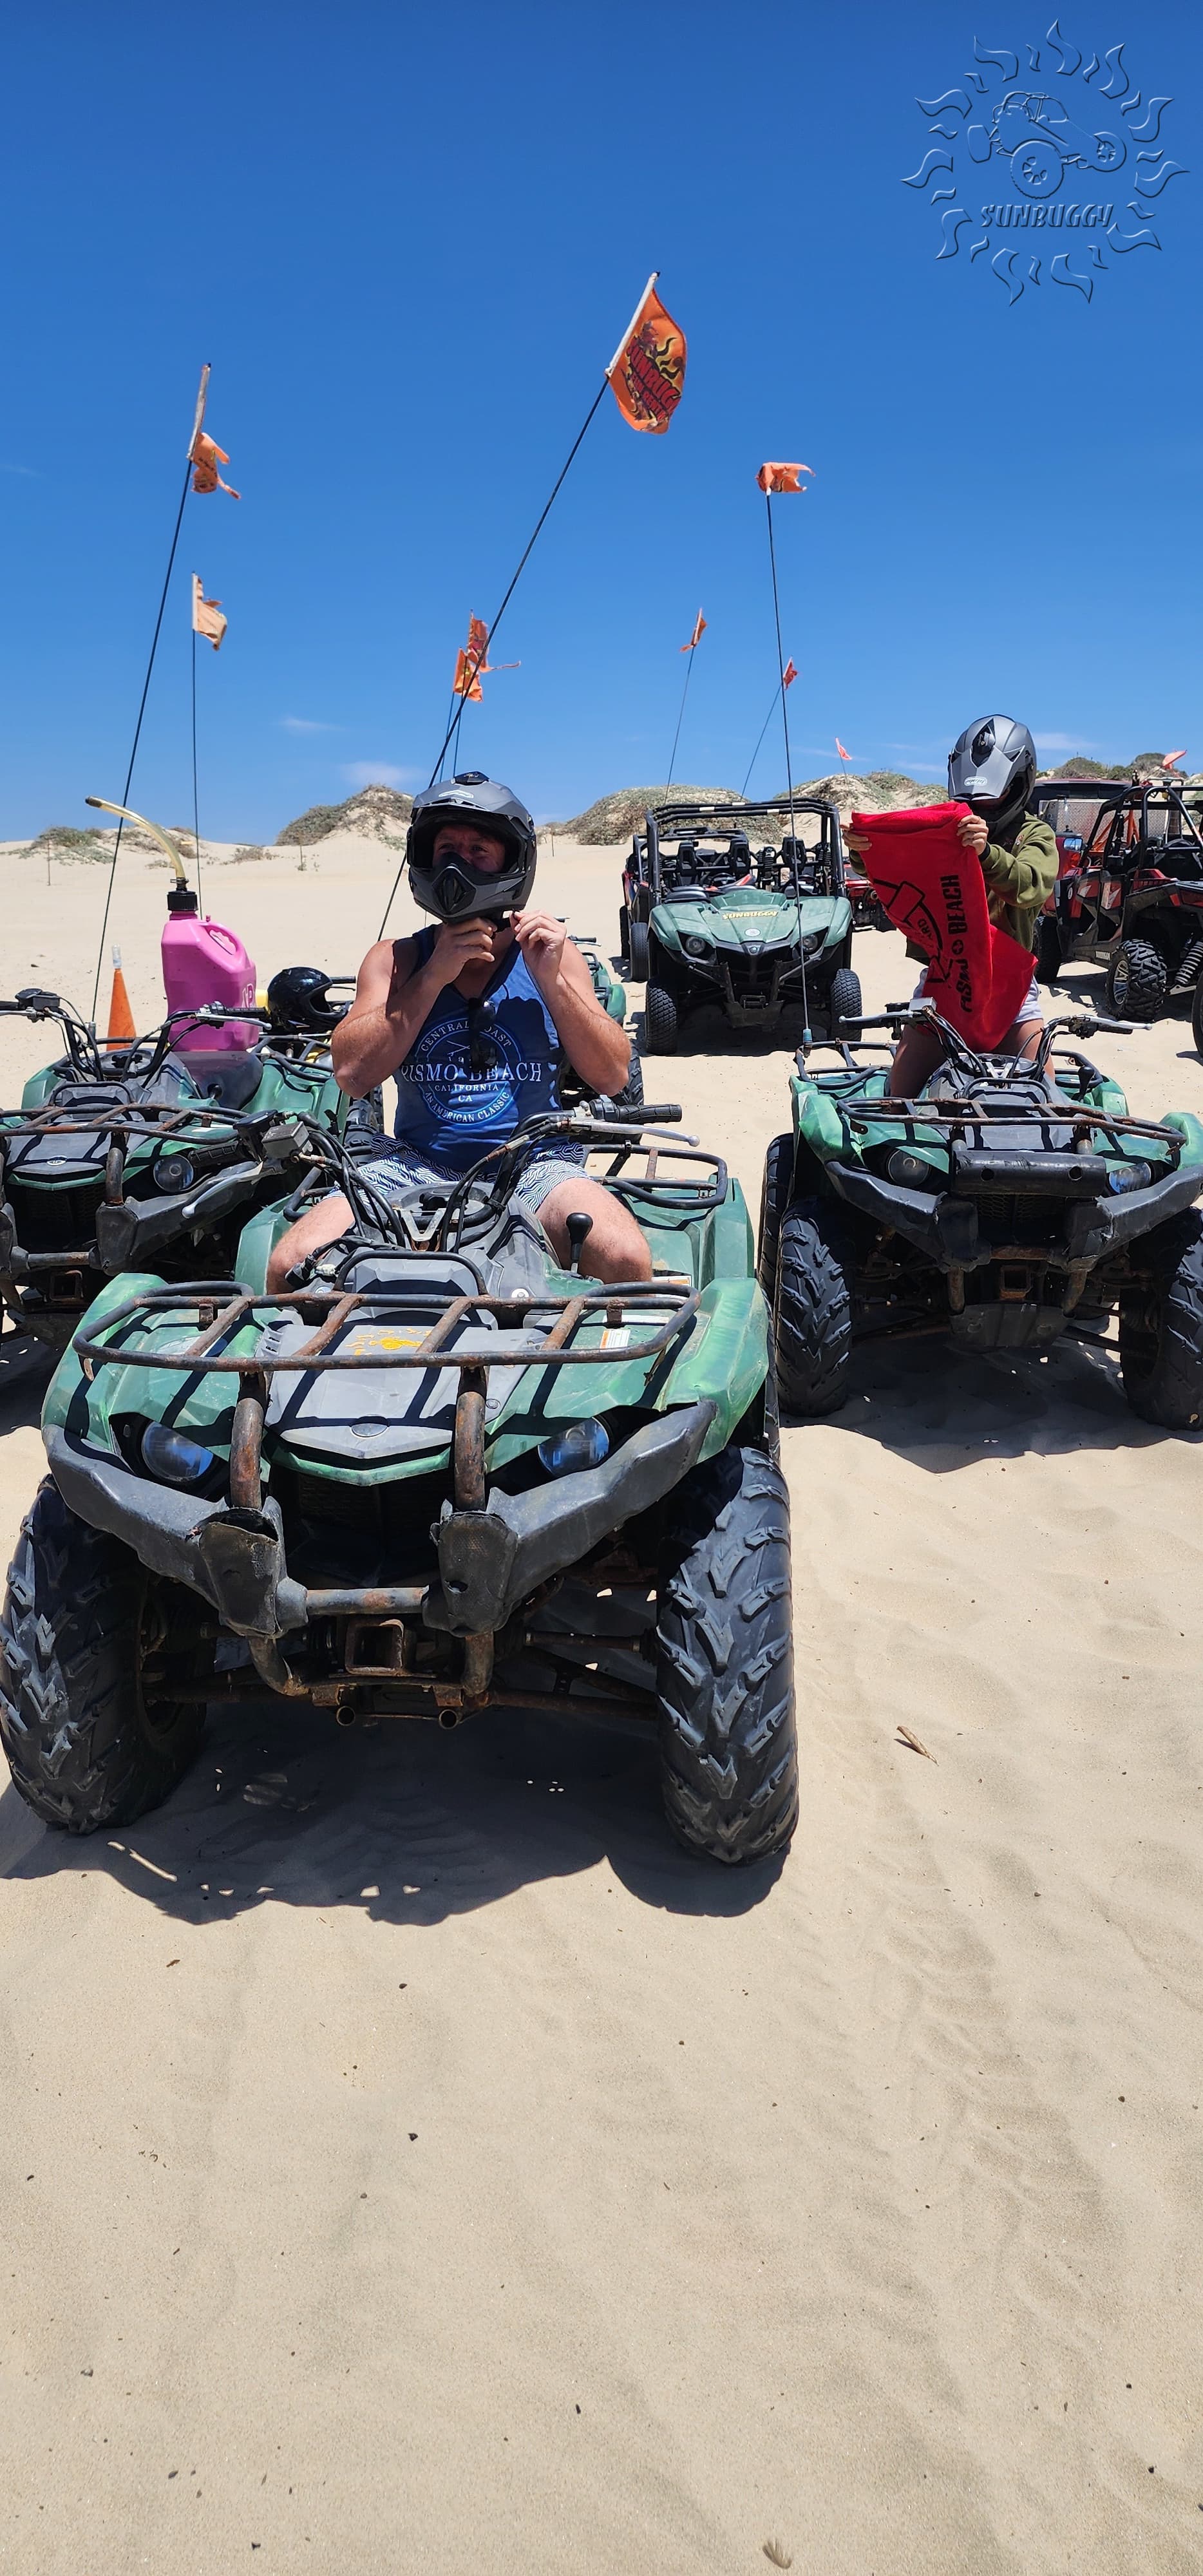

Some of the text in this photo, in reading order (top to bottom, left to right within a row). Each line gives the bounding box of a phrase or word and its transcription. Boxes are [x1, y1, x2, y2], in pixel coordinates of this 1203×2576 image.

[722, 911, 779, 920] SUNBUGGY
[940, 875, 968, 934] BEACH
[420, 1021, 469, 1052] CENTRAL
[431, 1103, 475, 1122] AMERICAN
[477, 1092, 510, 1120] CLASSIC
[458, 1094, 473, 1103] CA
